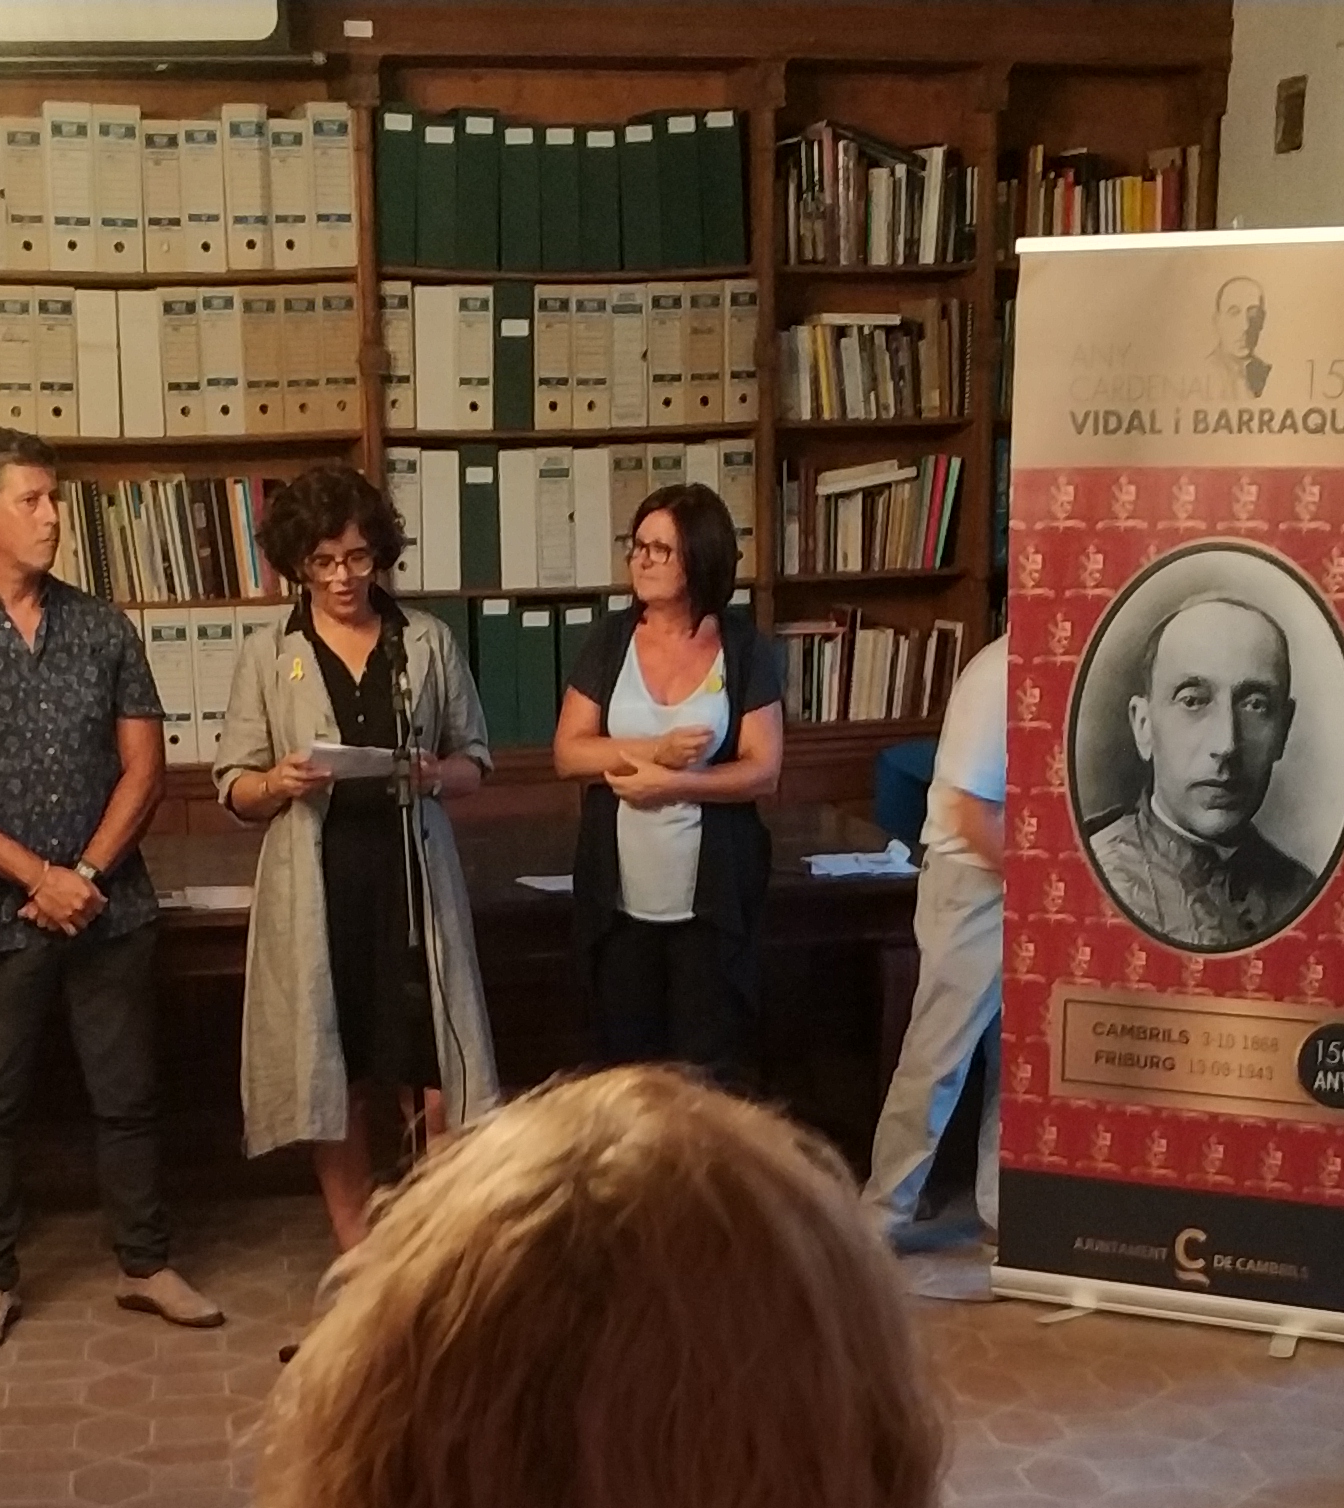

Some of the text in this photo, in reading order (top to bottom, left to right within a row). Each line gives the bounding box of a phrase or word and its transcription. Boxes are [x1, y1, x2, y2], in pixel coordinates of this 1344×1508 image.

[1069, 407, 1163, 437] VIDAL
[1091, 1020, 1191, 1046] CAMBRILS
[1094, 1049, 1177, 1072] FRIBURG
[1212, 1254, 1233, 1271] DE
